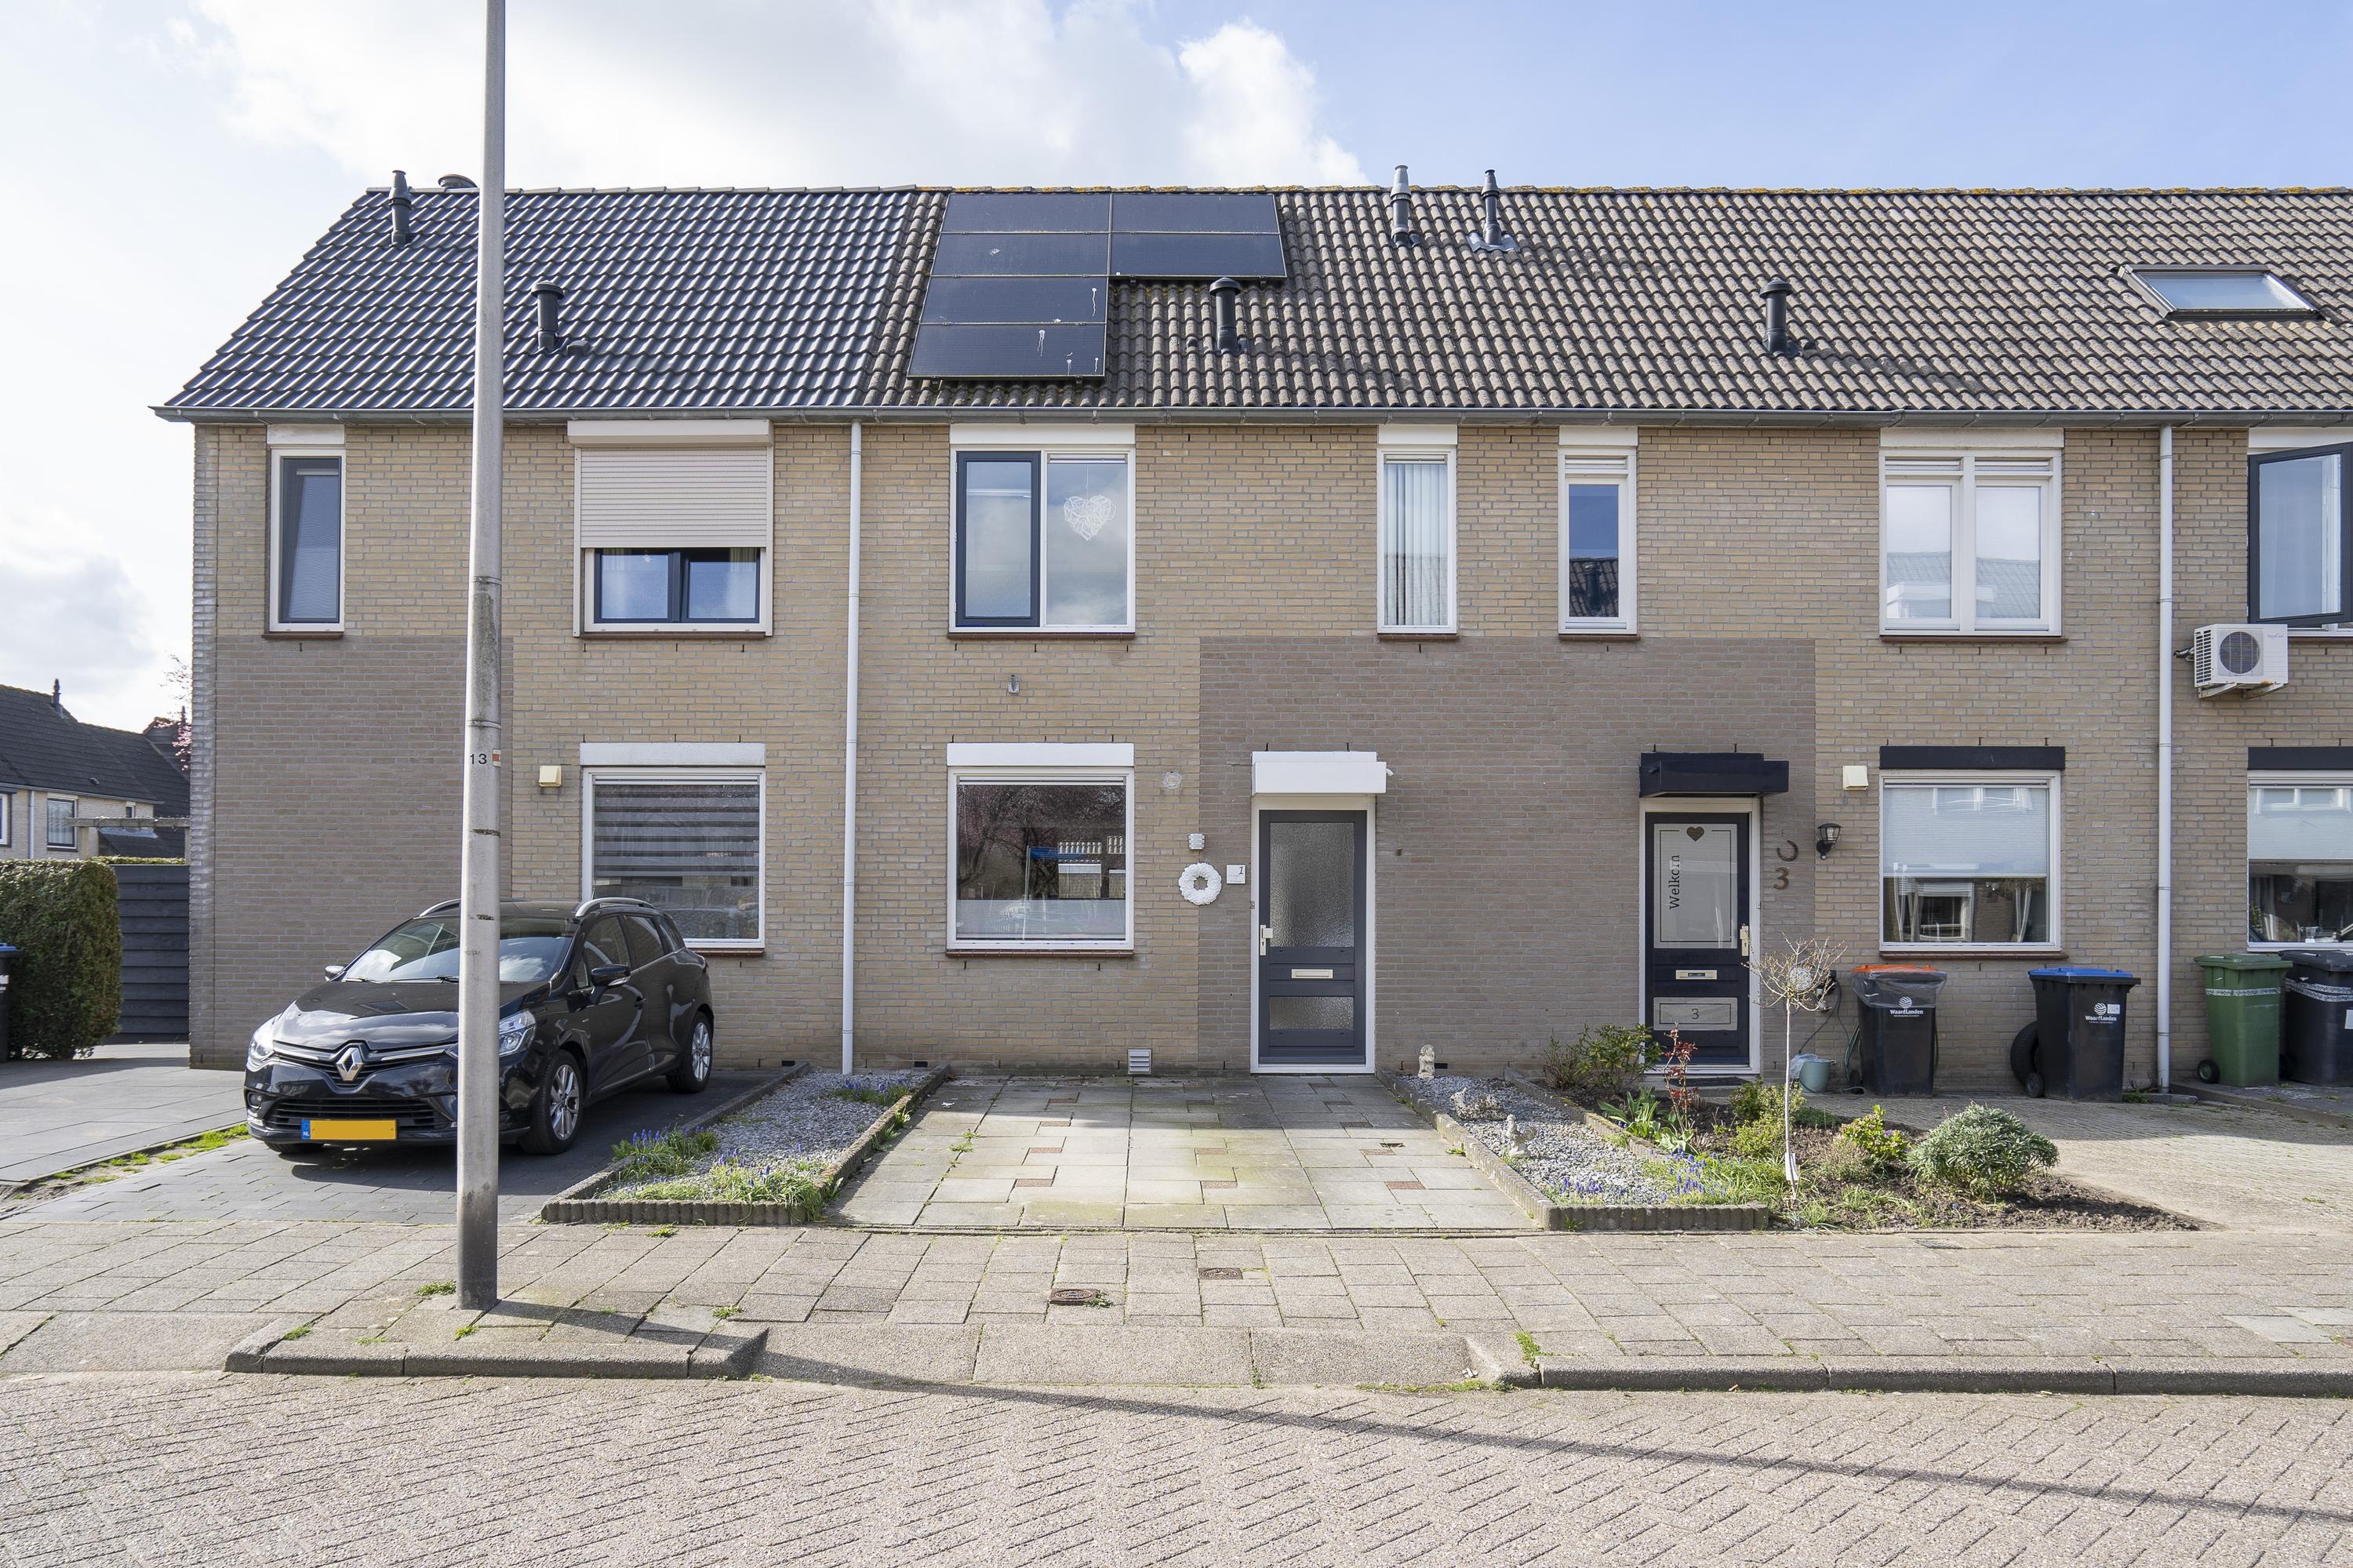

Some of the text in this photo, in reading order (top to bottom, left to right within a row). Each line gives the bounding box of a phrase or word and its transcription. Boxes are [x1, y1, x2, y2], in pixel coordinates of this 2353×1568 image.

[470, 753, 487, 765] 13
[1238, 866, 1244, 875] 1
[1773, 866, 1789, 890] 3
[1691, 1008, 1700, 1020] 3
